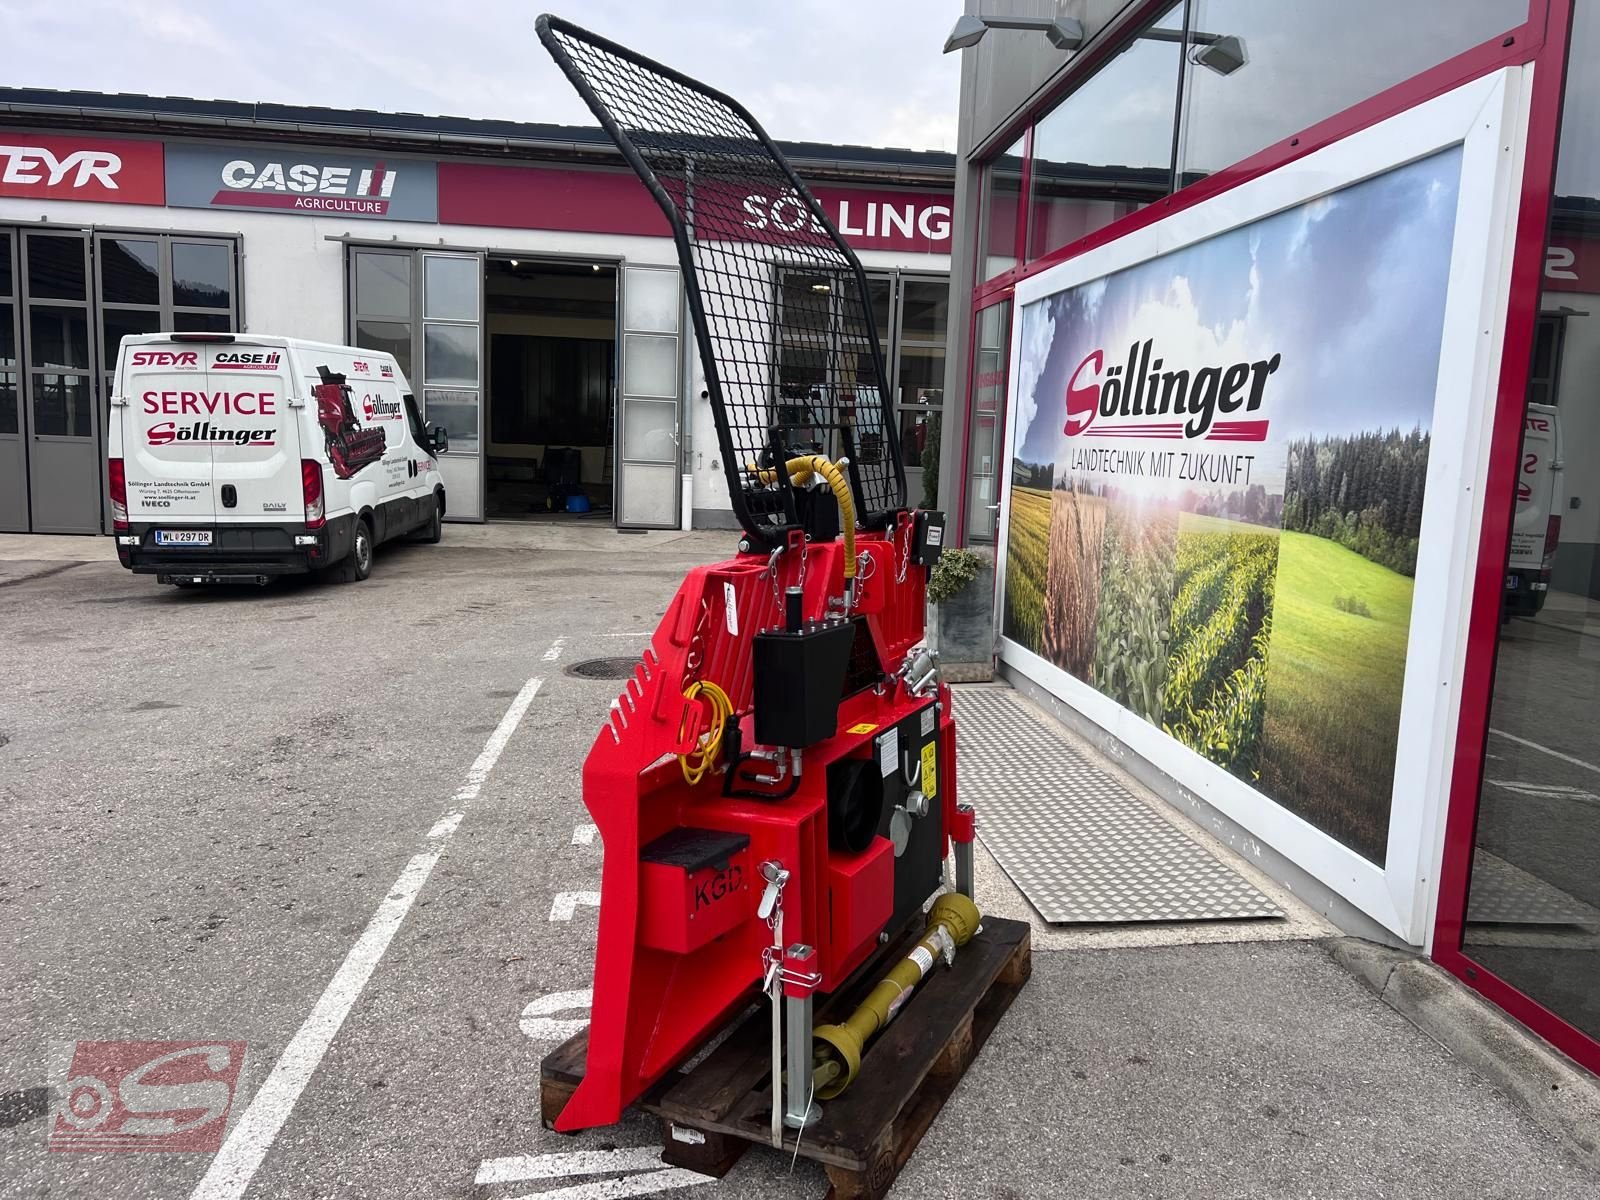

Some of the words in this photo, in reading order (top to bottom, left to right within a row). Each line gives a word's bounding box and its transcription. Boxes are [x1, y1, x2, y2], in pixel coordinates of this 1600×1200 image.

[0, 146, 122, 189] EYR
[221, 160, 351, 195] CASE
[295, 198, 381, 213] AGRICULTURE
[131, 352, 198, 366] STEYR
[215, 353, 263, 364] CASE
[1063, 338, 1281, 438] Söllinger
[142, 391, 276, 415] SERVICE
[363, 393, 401, 421] Söllinger
[147, 422, 277, 446] Söllinger
[1071, 448, 1146, 476] LANDTECHNIK
[1149, 451, 1175, 478] MIT
[1179, 453, 1255, 485] ZUKUNFT
[163, 532, 174, 541] WL
[180, 533, 196, 541] 297
[198, 533, 209, 542] DR
[695, 865, 742, 912] KGD
